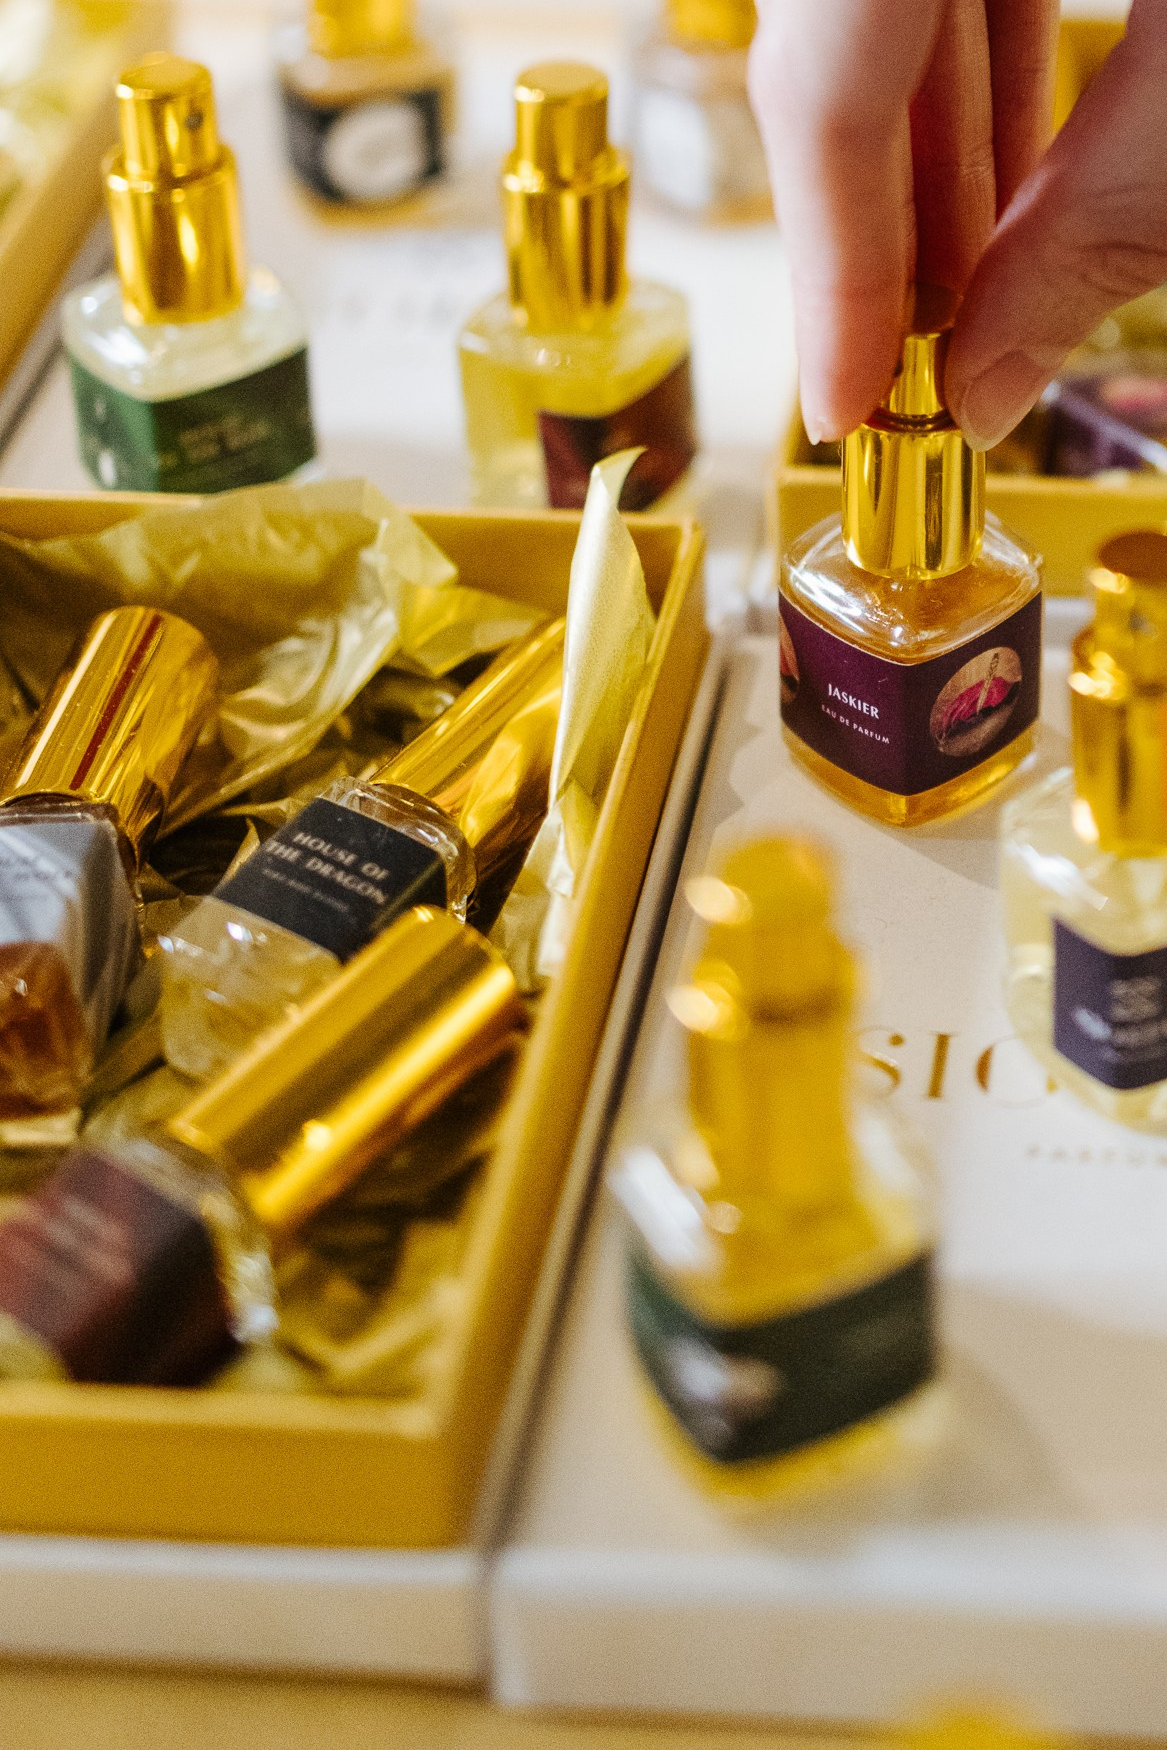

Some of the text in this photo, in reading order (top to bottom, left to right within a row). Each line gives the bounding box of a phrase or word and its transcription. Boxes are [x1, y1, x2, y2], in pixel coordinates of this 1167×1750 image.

[821, 704, 890, 744] EAU DE PARFUM
[264, 839, 301, 863] THE
[292, 832, 358, 867] HOUSE
